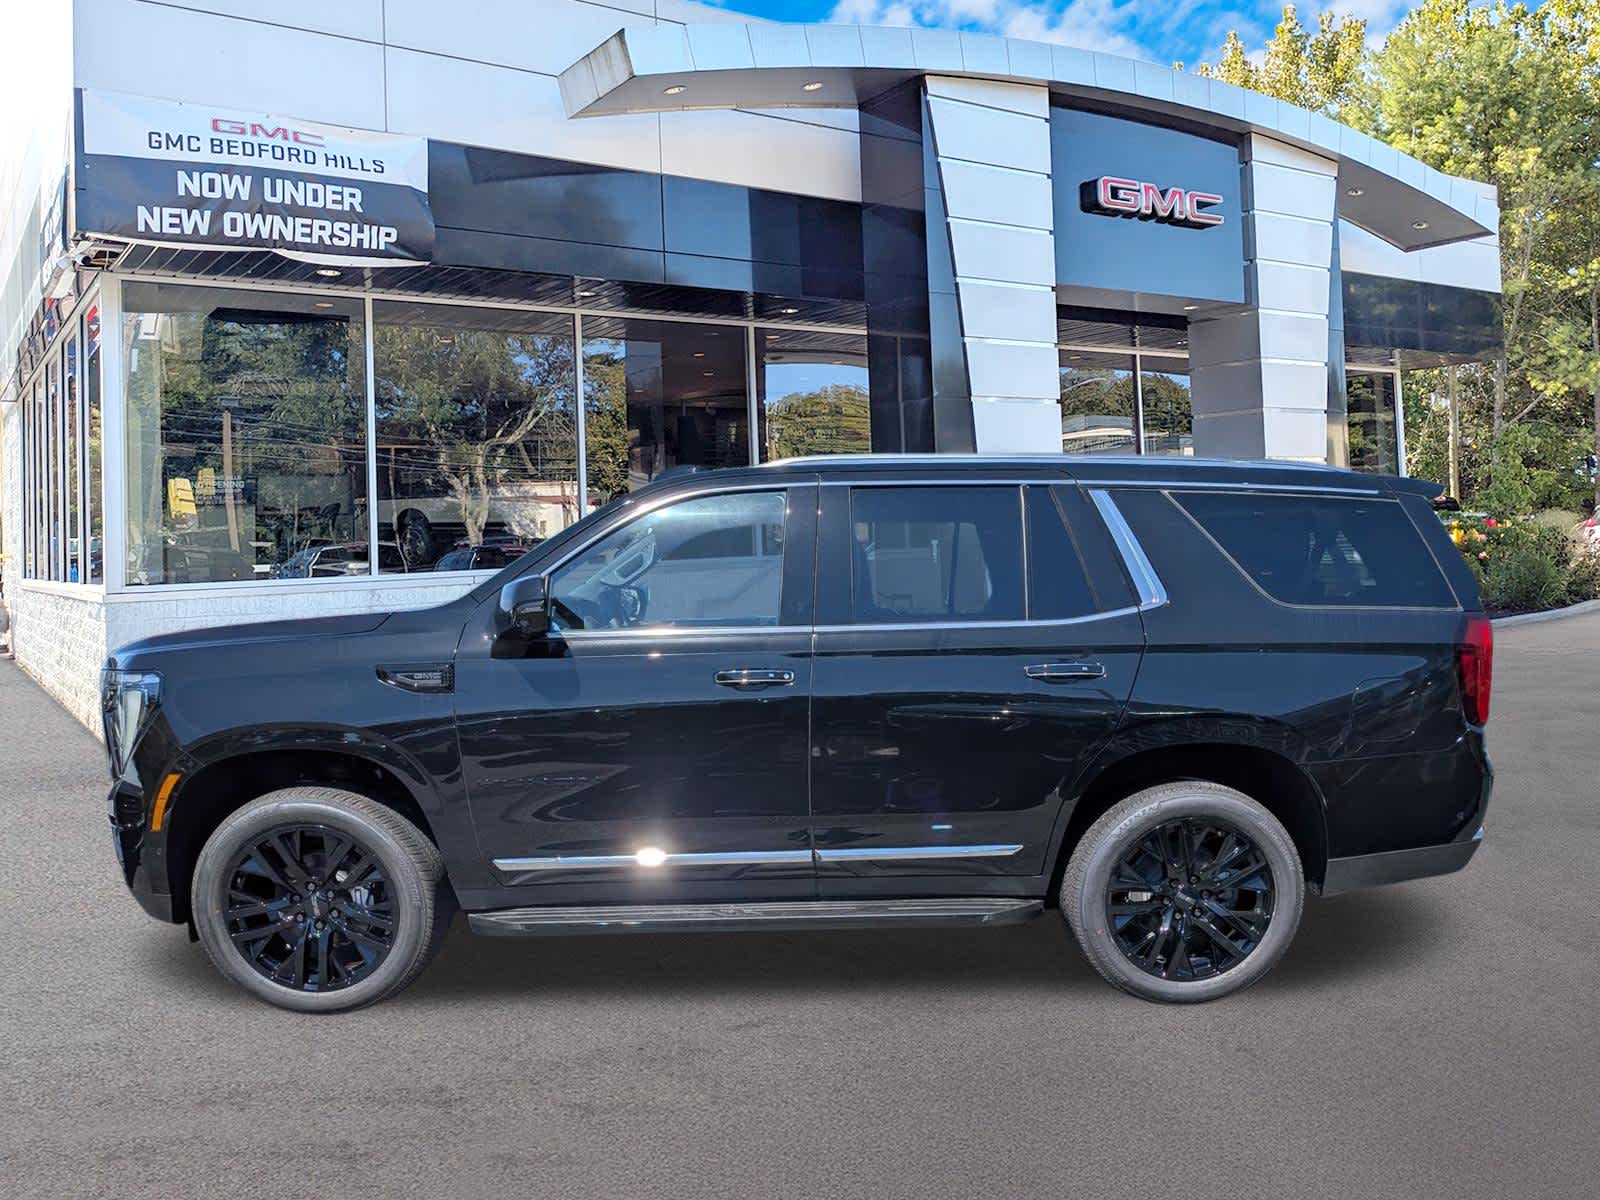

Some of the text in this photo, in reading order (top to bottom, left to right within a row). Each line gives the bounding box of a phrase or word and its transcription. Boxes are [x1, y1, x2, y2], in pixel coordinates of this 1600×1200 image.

[148, 131, 385, 174] GMC BEDFORD HILLS
[211, 118, 326, 148] GMC
[177, 170, 363, 213] NOW UNDER
[1096, 175, 1225, 226] GMC
[136, 205, 398, 250] NEW OWNERSHIP
